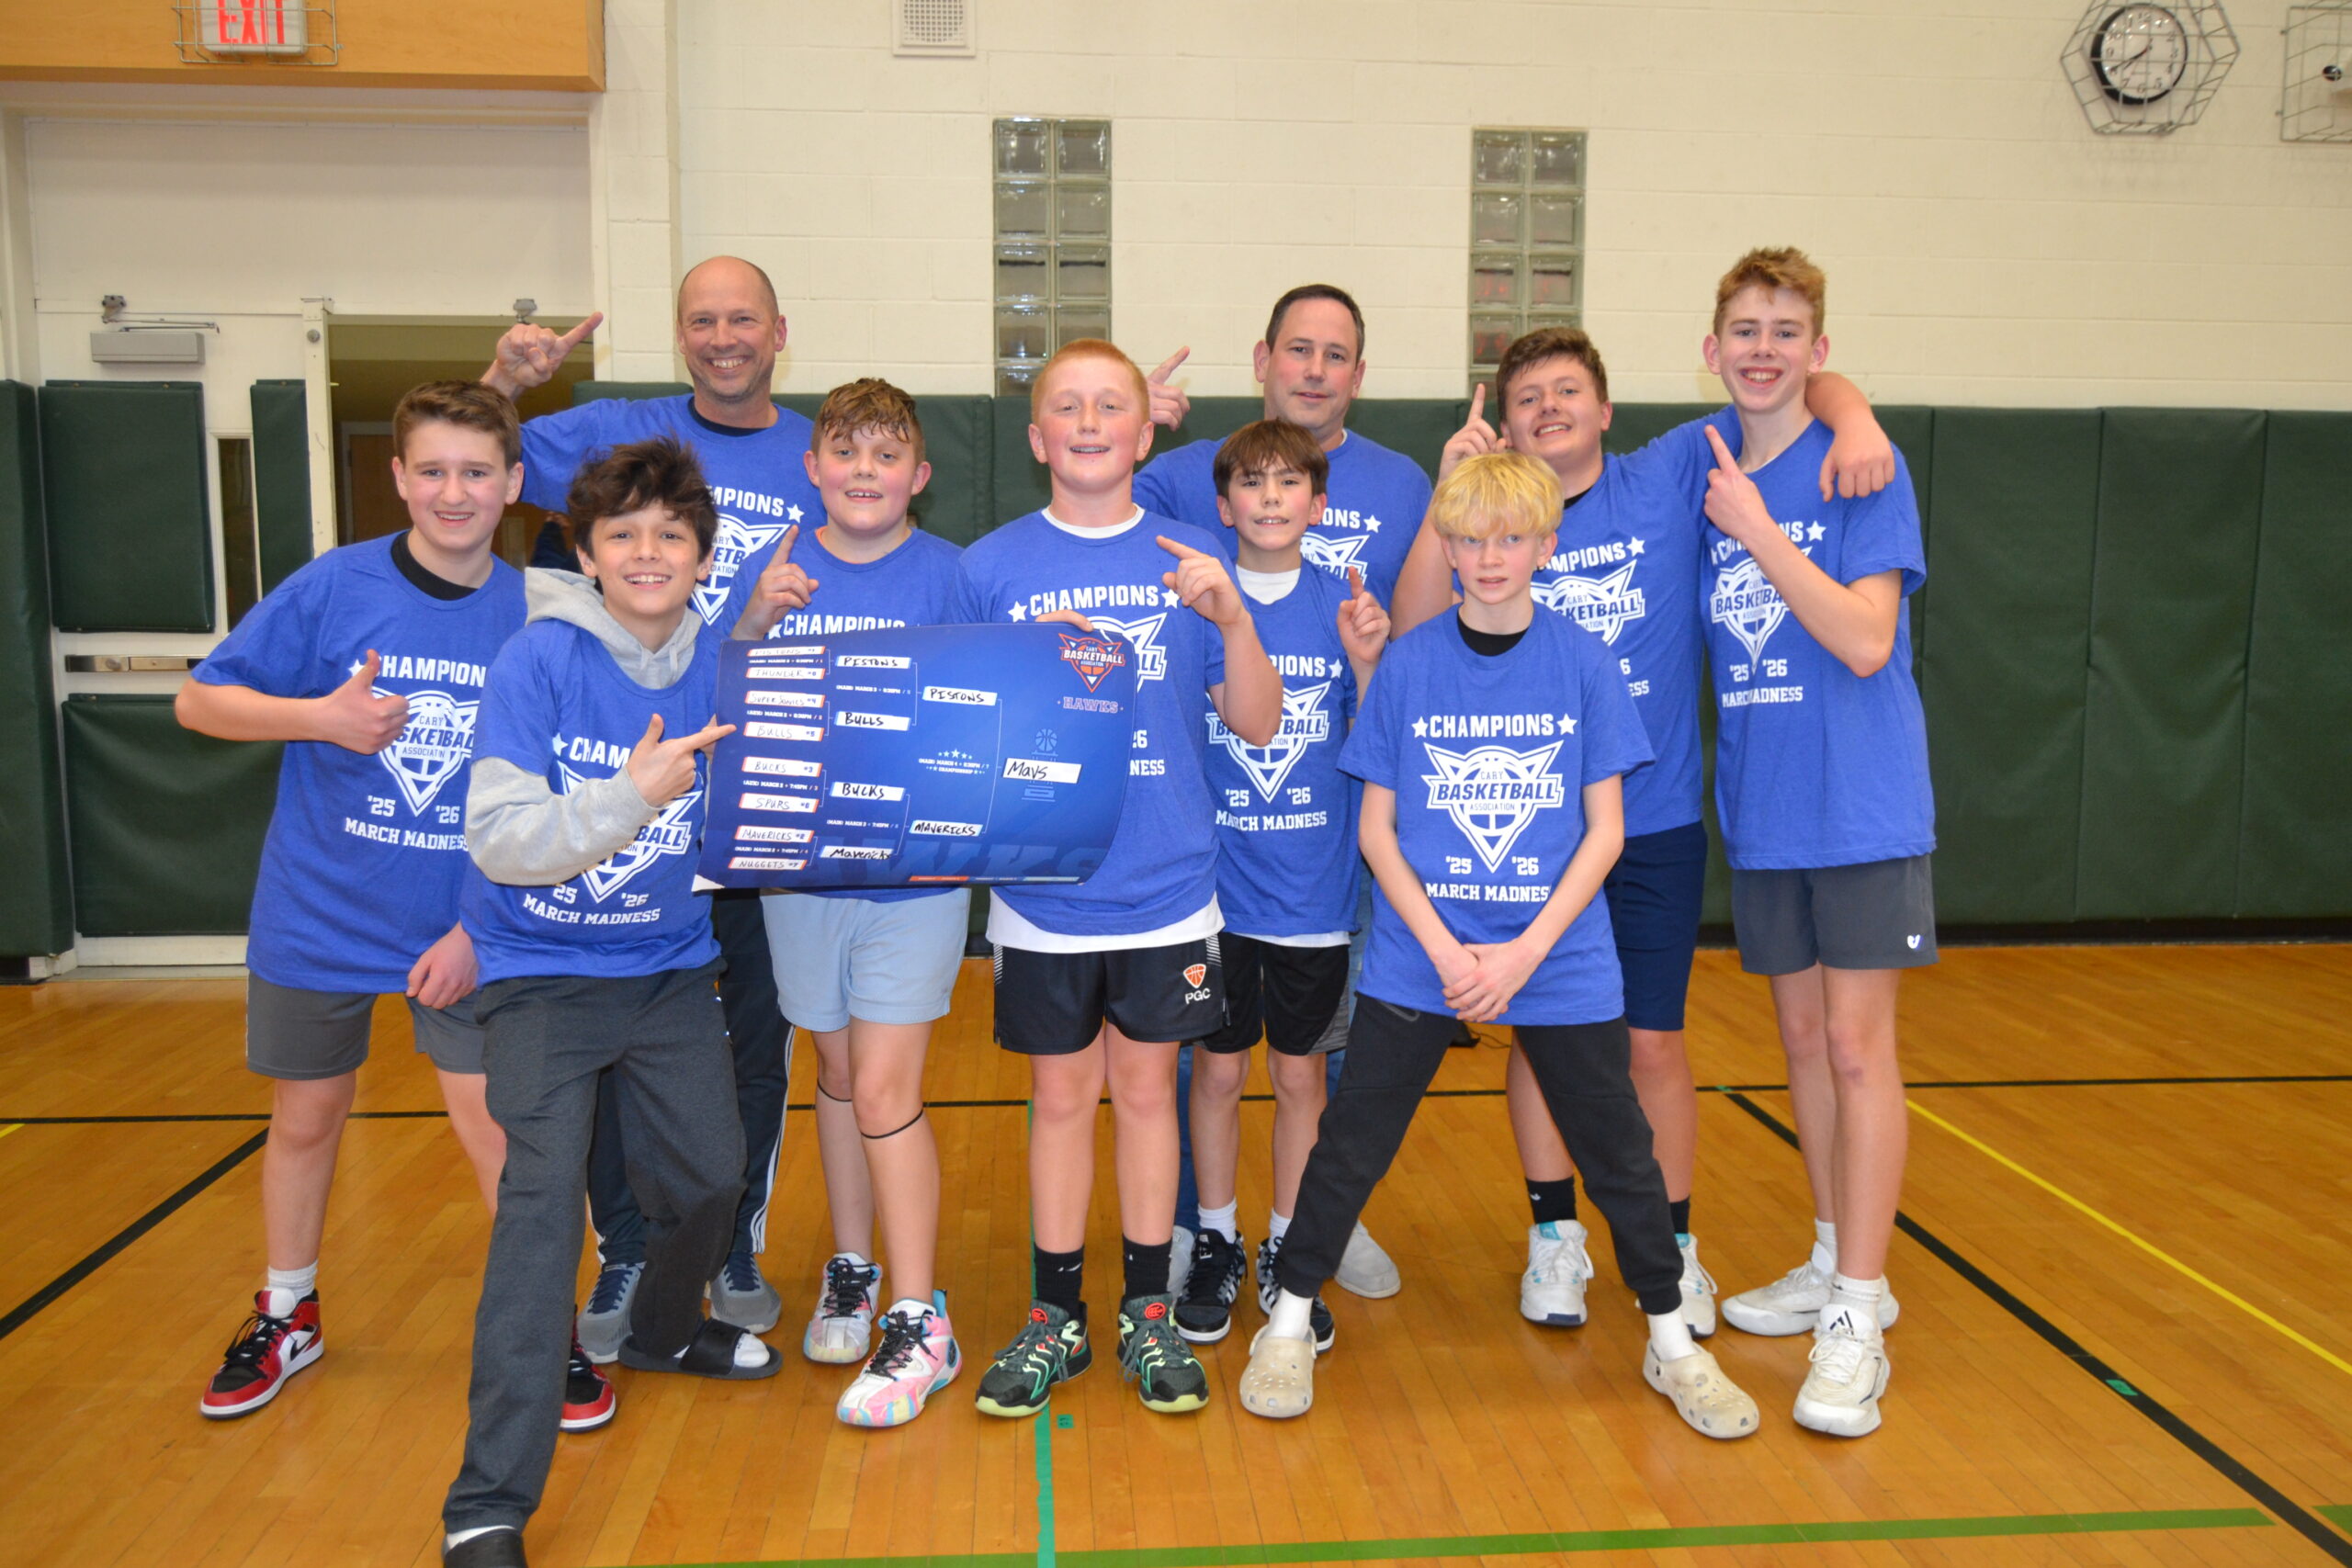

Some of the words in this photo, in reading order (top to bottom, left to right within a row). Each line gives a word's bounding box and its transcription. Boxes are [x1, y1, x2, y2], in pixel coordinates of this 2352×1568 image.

[1545, 541, 1626, 573] MPIONS
[1030, 584, 1159, 616] CHAMPIONS
[1556, 597, 1638, 621] KETBALL
[843, 656, 899, 667] PISTONS
[1063, 649, 1123, 664] BASKETBALL
[377, 655, 487, 687] HAMPION
[1729, 663, 1749, 682] '25
[1762, 659, 1788, 677] '26
[930, 688, 985, 703] PISTONS
[1063, 696, 1119, 714] HAWKS
[419, 716, 444, 727] CARY
[844, 712, 884, 727] BULLS
[1430, 713, 1555, 739] CHAMPIONS
[753, 761, 786, 773] BUCKS
[1129, 758, 1165, 776] NESS
[1480, 771, 1504, 780] CARY
[842, 783, 885, 800] BUCKS
[1225, 788, 1250, 807] '25
[1286, 786, 1311, 806] '26
[1436, 782, 1555, 801] BASKETBALL
[368, 795, 396, 818] '25
[435, 805, 460, 824] '26
[755, 797, 790, 810] SPURS
[1470, 802, 1515, 811] ASSOCIATION
[914, 822, 977, 836] MAVERICKS
[1262, 810, 1328, 831] MADNESS
[345, 817, 401, 844] MARCH
[741, 829, 792, 840] MAVERICKS
[1445, 855, 1473, 874] '25
[1511, 855, 1540, 875] '26
[1425, 883, 1480, 900] MARCH
[1485, 884, 1552, 902] MADNES
[523, 893, 582, 924] MARCH
[583, 908, 662, 925] MADNESS
[1184, 987, 1212, 1005] PGC
